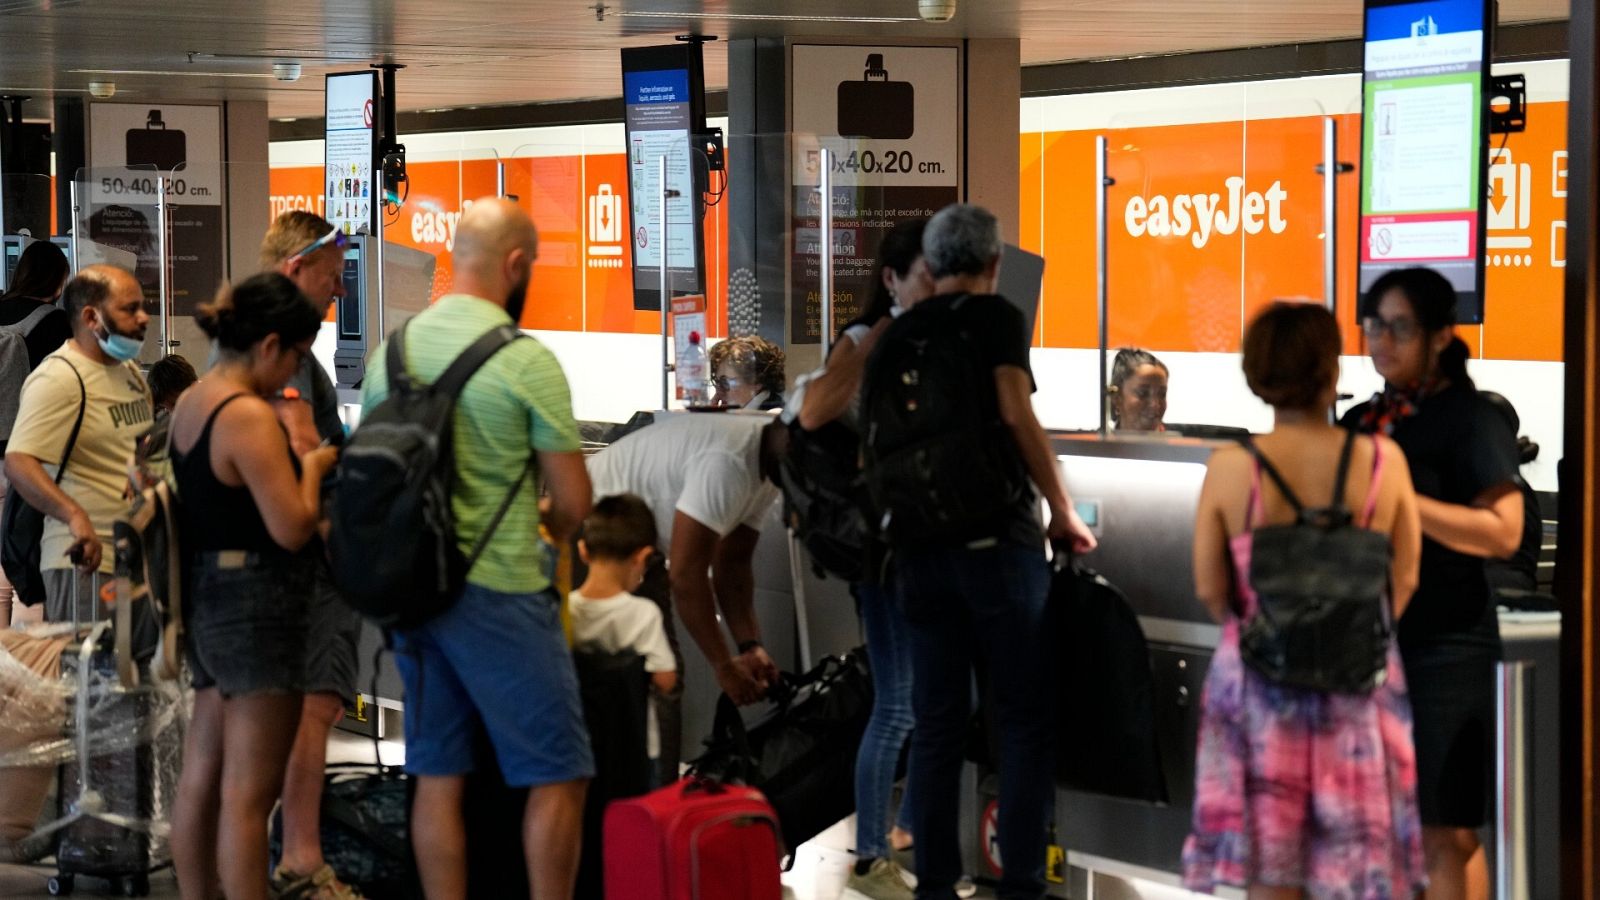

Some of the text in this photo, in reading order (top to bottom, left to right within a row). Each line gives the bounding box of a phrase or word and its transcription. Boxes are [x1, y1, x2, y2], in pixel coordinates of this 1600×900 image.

[806, 150, 945, 174] 5x40x20 cm.
[190, 186, 212, 196] cm.
[885, 209, 896, 218] pot
[1124, 176, 1287, 249] easyJet
[411, 199, 473, 253] easy
[806, 242, 856, 255] Atttion
